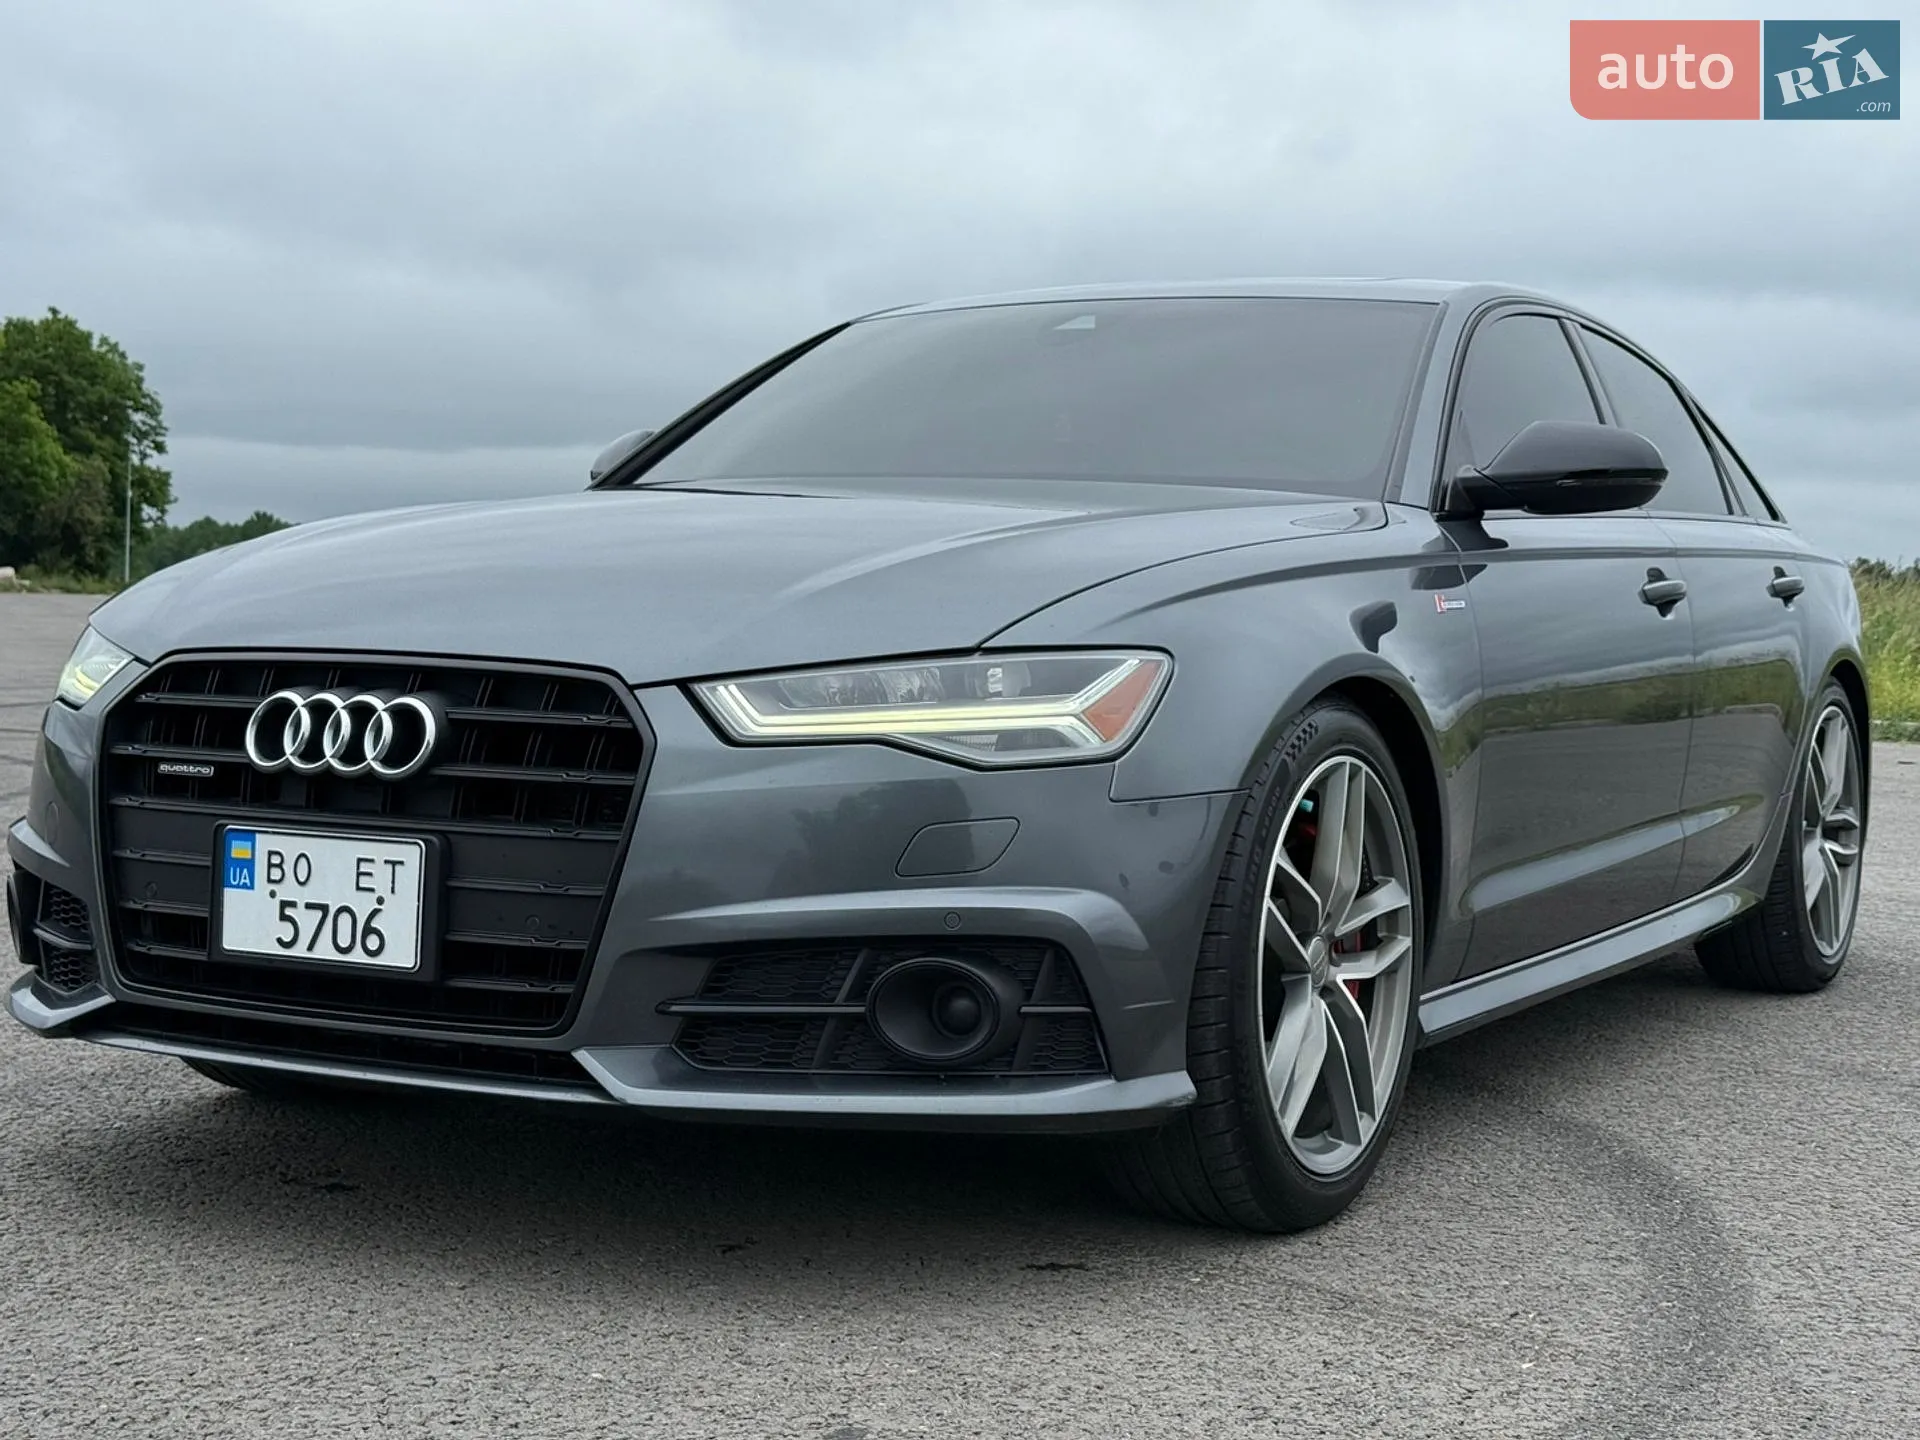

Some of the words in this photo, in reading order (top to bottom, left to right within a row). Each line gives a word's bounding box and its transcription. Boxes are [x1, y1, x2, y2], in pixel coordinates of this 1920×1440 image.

[229, 866, 251, 887] UA
[355, 856, 405, 894] ET
[275, 898, 386, 958] 5706
